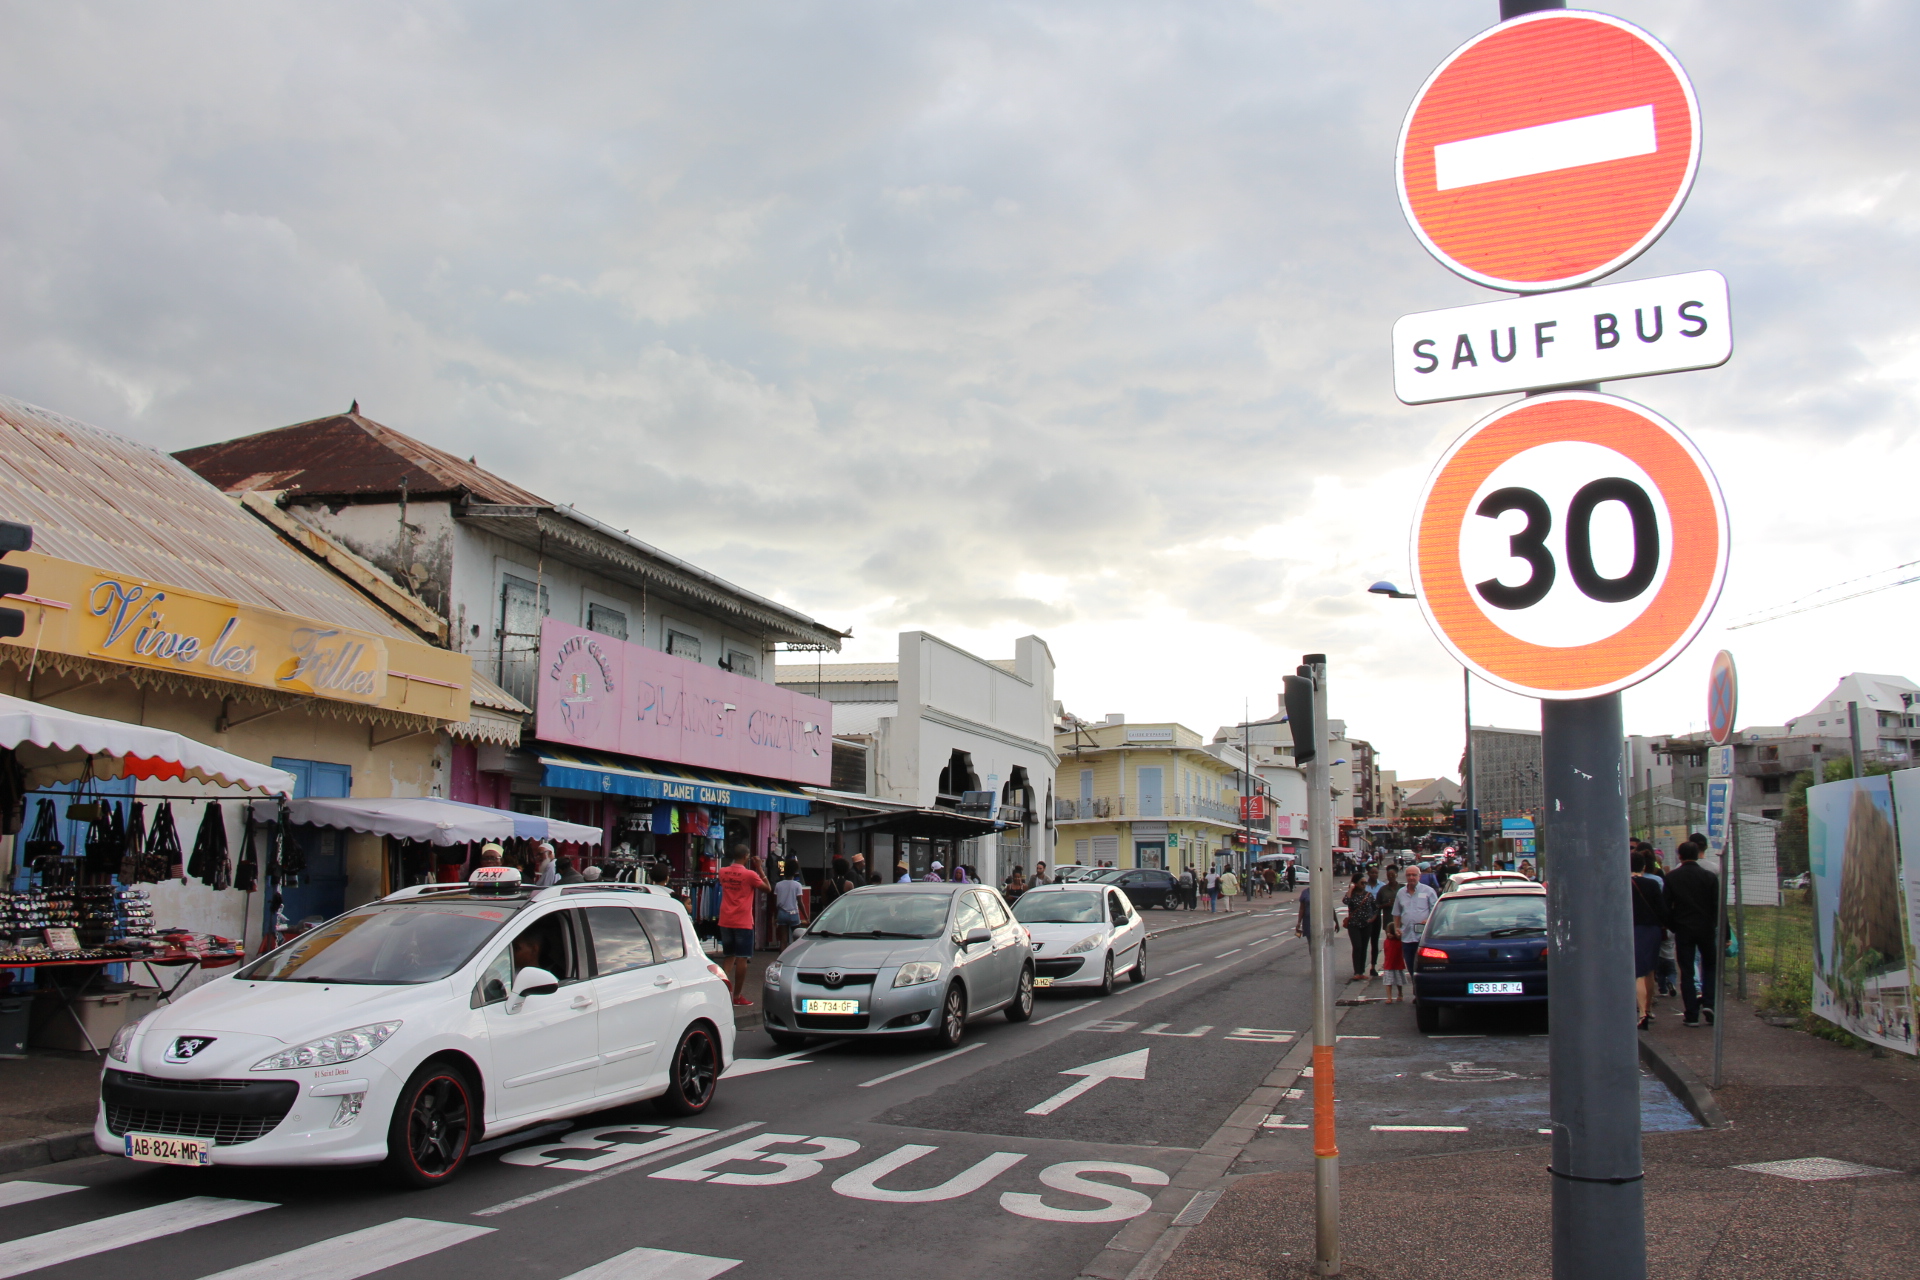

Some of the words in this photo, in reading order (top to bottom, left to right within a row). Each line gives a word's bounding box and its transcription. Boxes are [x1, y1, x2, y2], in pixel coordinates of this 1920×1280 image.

[1412, 320, 1557, 374] SAUF
[1593, 300, 1708, 351] BUS
[1475, 476, 1660, 611] 30
[90, 581, 201, 663] Vive
[209, 617, 258, 675] les
[278, 627, 377, 695] Filles
[700, 787, 731, 804] CHAUSS
[1474, 984, 1490, 992] 963
[1492, 983, 1508, 992] BJR
[1068, 1019, 1297, 1043] BUS
[335, 1068, 349, 1076] Denis
[134, 1138, 199, 1160] AB-824-MR
[647, 1132, 1171, 1223] BUS
